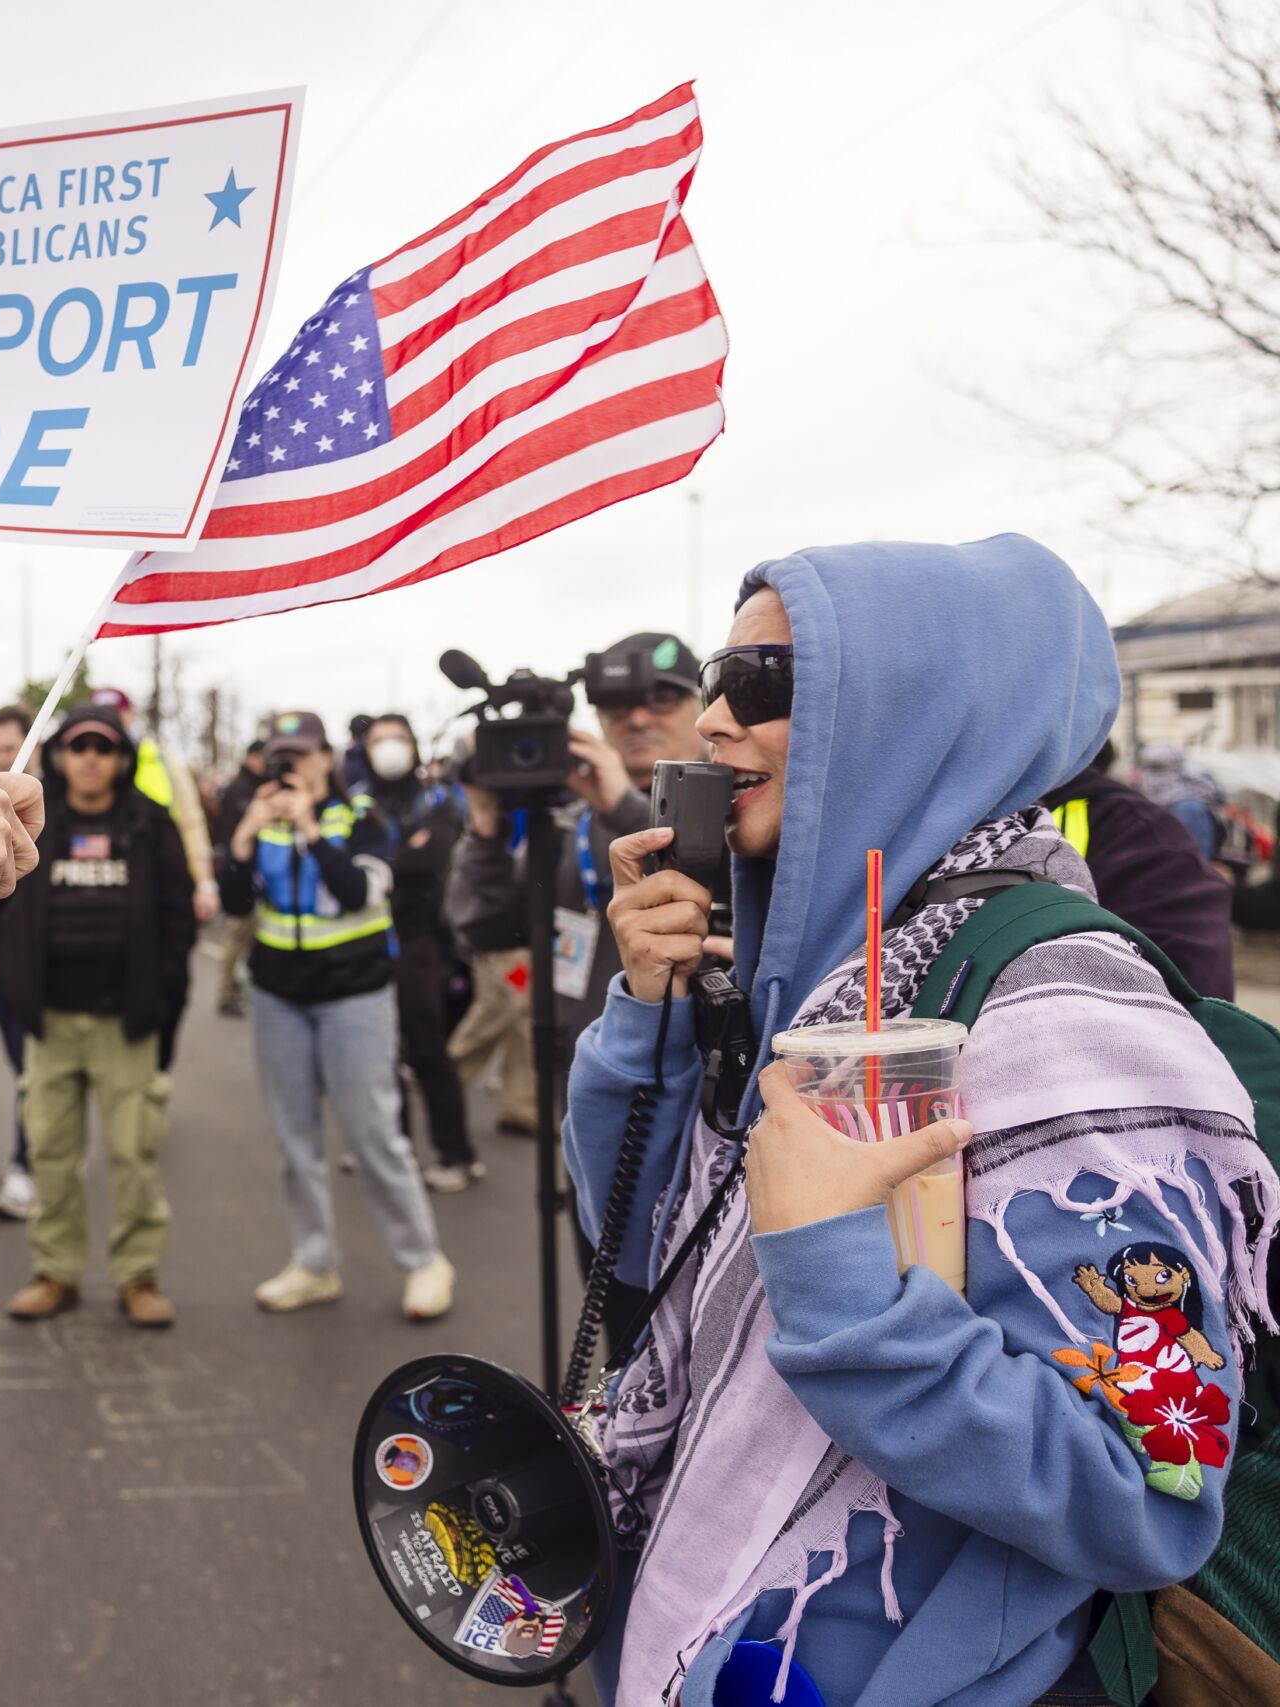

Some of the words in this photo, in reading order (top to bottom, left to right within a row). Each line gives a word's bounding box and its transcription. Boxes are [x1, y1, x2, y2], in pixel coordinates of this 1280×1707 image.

[58, 157, 170, 208] FIRST
[484, 1495, 505, 1527] PYLE
[417, 1529, 463, 1596] AFRAID
[464, 1629, 498, 1651] ICE
[471, 1619, 502, 1636] FUCK
